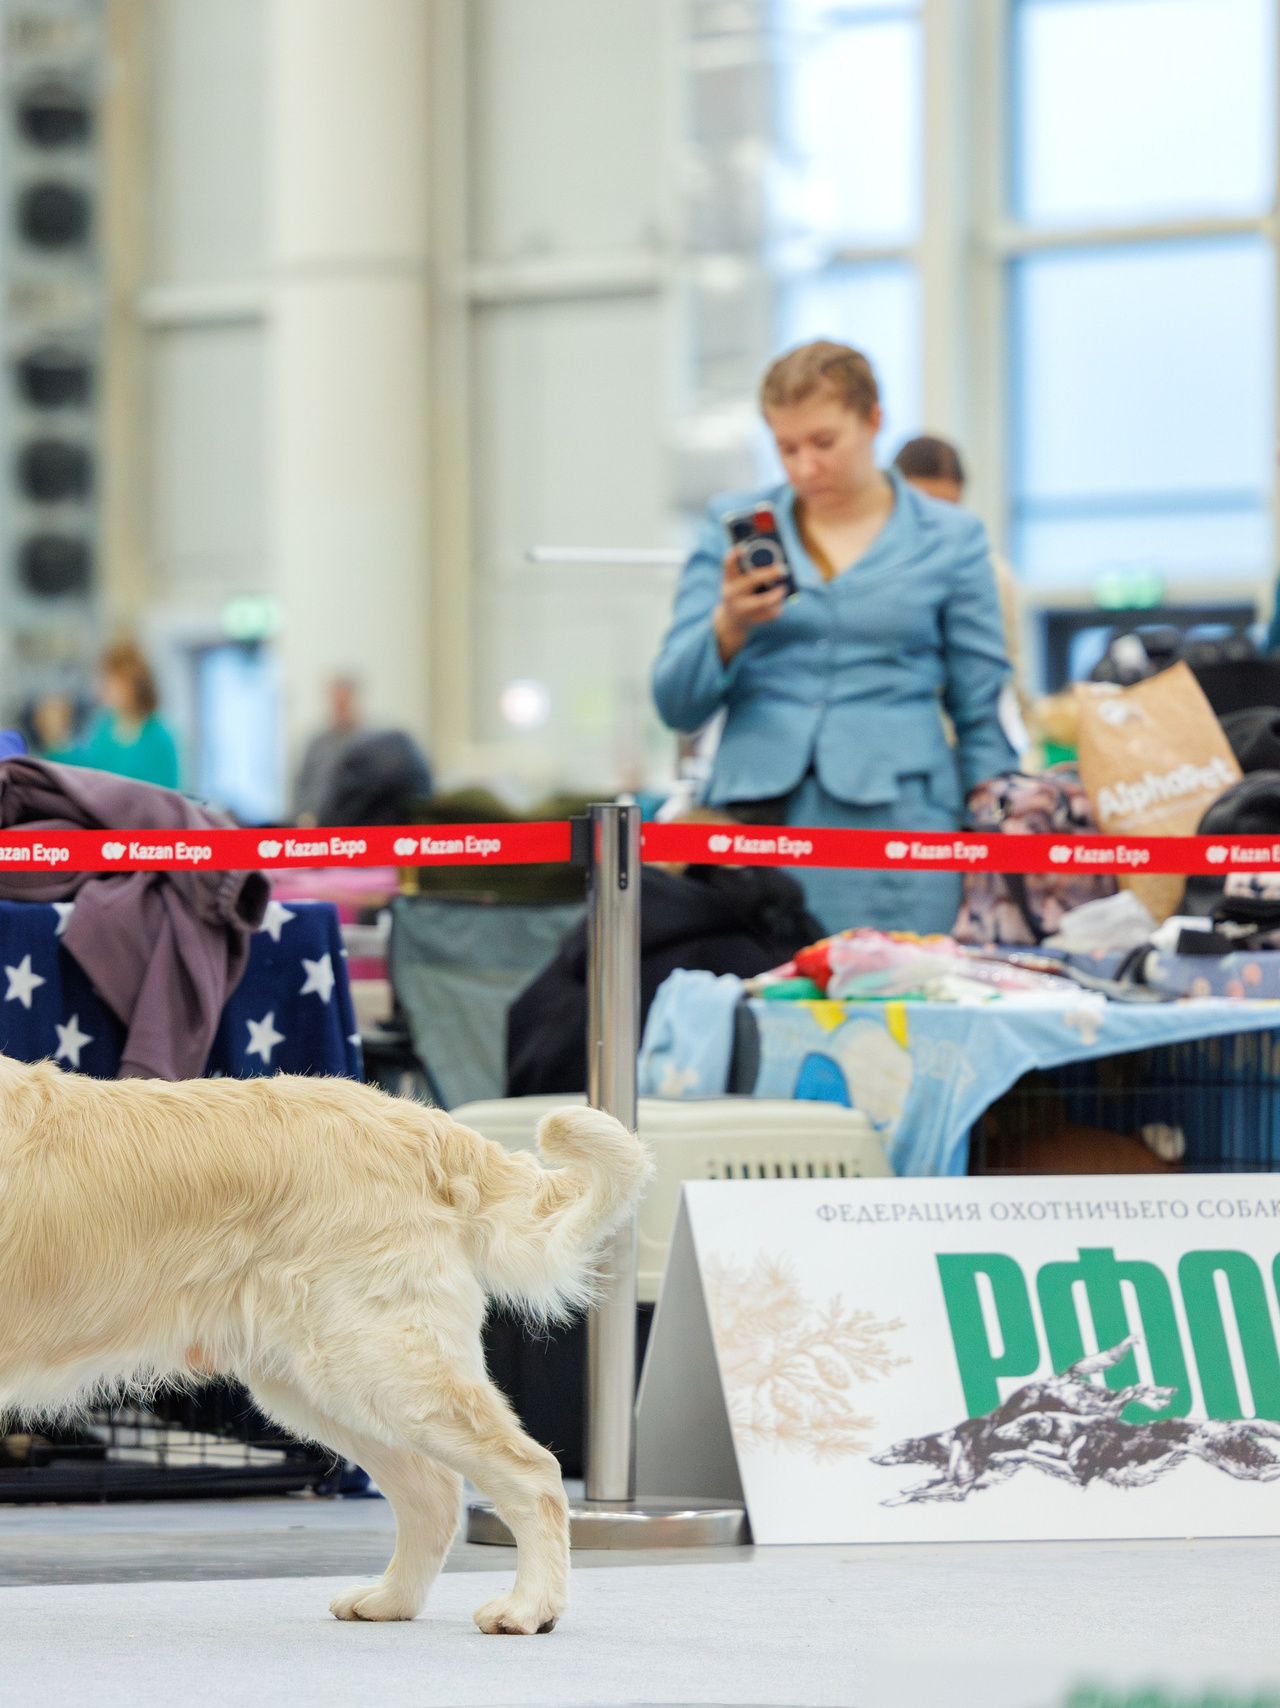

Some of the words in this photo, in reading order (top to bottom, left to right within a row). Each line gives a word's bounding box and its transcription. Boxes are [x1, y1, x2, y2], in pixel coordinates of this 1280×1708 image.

[1096, 756, 1236, 823] AlphaPet
[33, 843, 69, 865] Expo
[129, 842, 173, 860] Kazan
[175, 842, 212, 864] Expo
[285, 839, 328, 857] Kazan
[330, 837, 367, 859] Expo
[420, 837, 463, 855] Kazan
[465, 835, 500, 857] Expo
[733, 835, 776, 853] Kazan
[777, 836, 813, 858] Expo
[910, 842, 952, 859] Kazan
[953, 841, 988, 863] Expo
[1074, 846, 1115, 863] Kazan
[1116, 845, 1150, 867] Expo
[1230, 845, 1270, 863] Kazan
[816, 1202, 982, 1224] ФЕДЕРАЦИЯ
[990, 1200, 1189, 1221] ОХОТНИЧЬЕГО
[935, 1247, 1280, 1425] РФО
